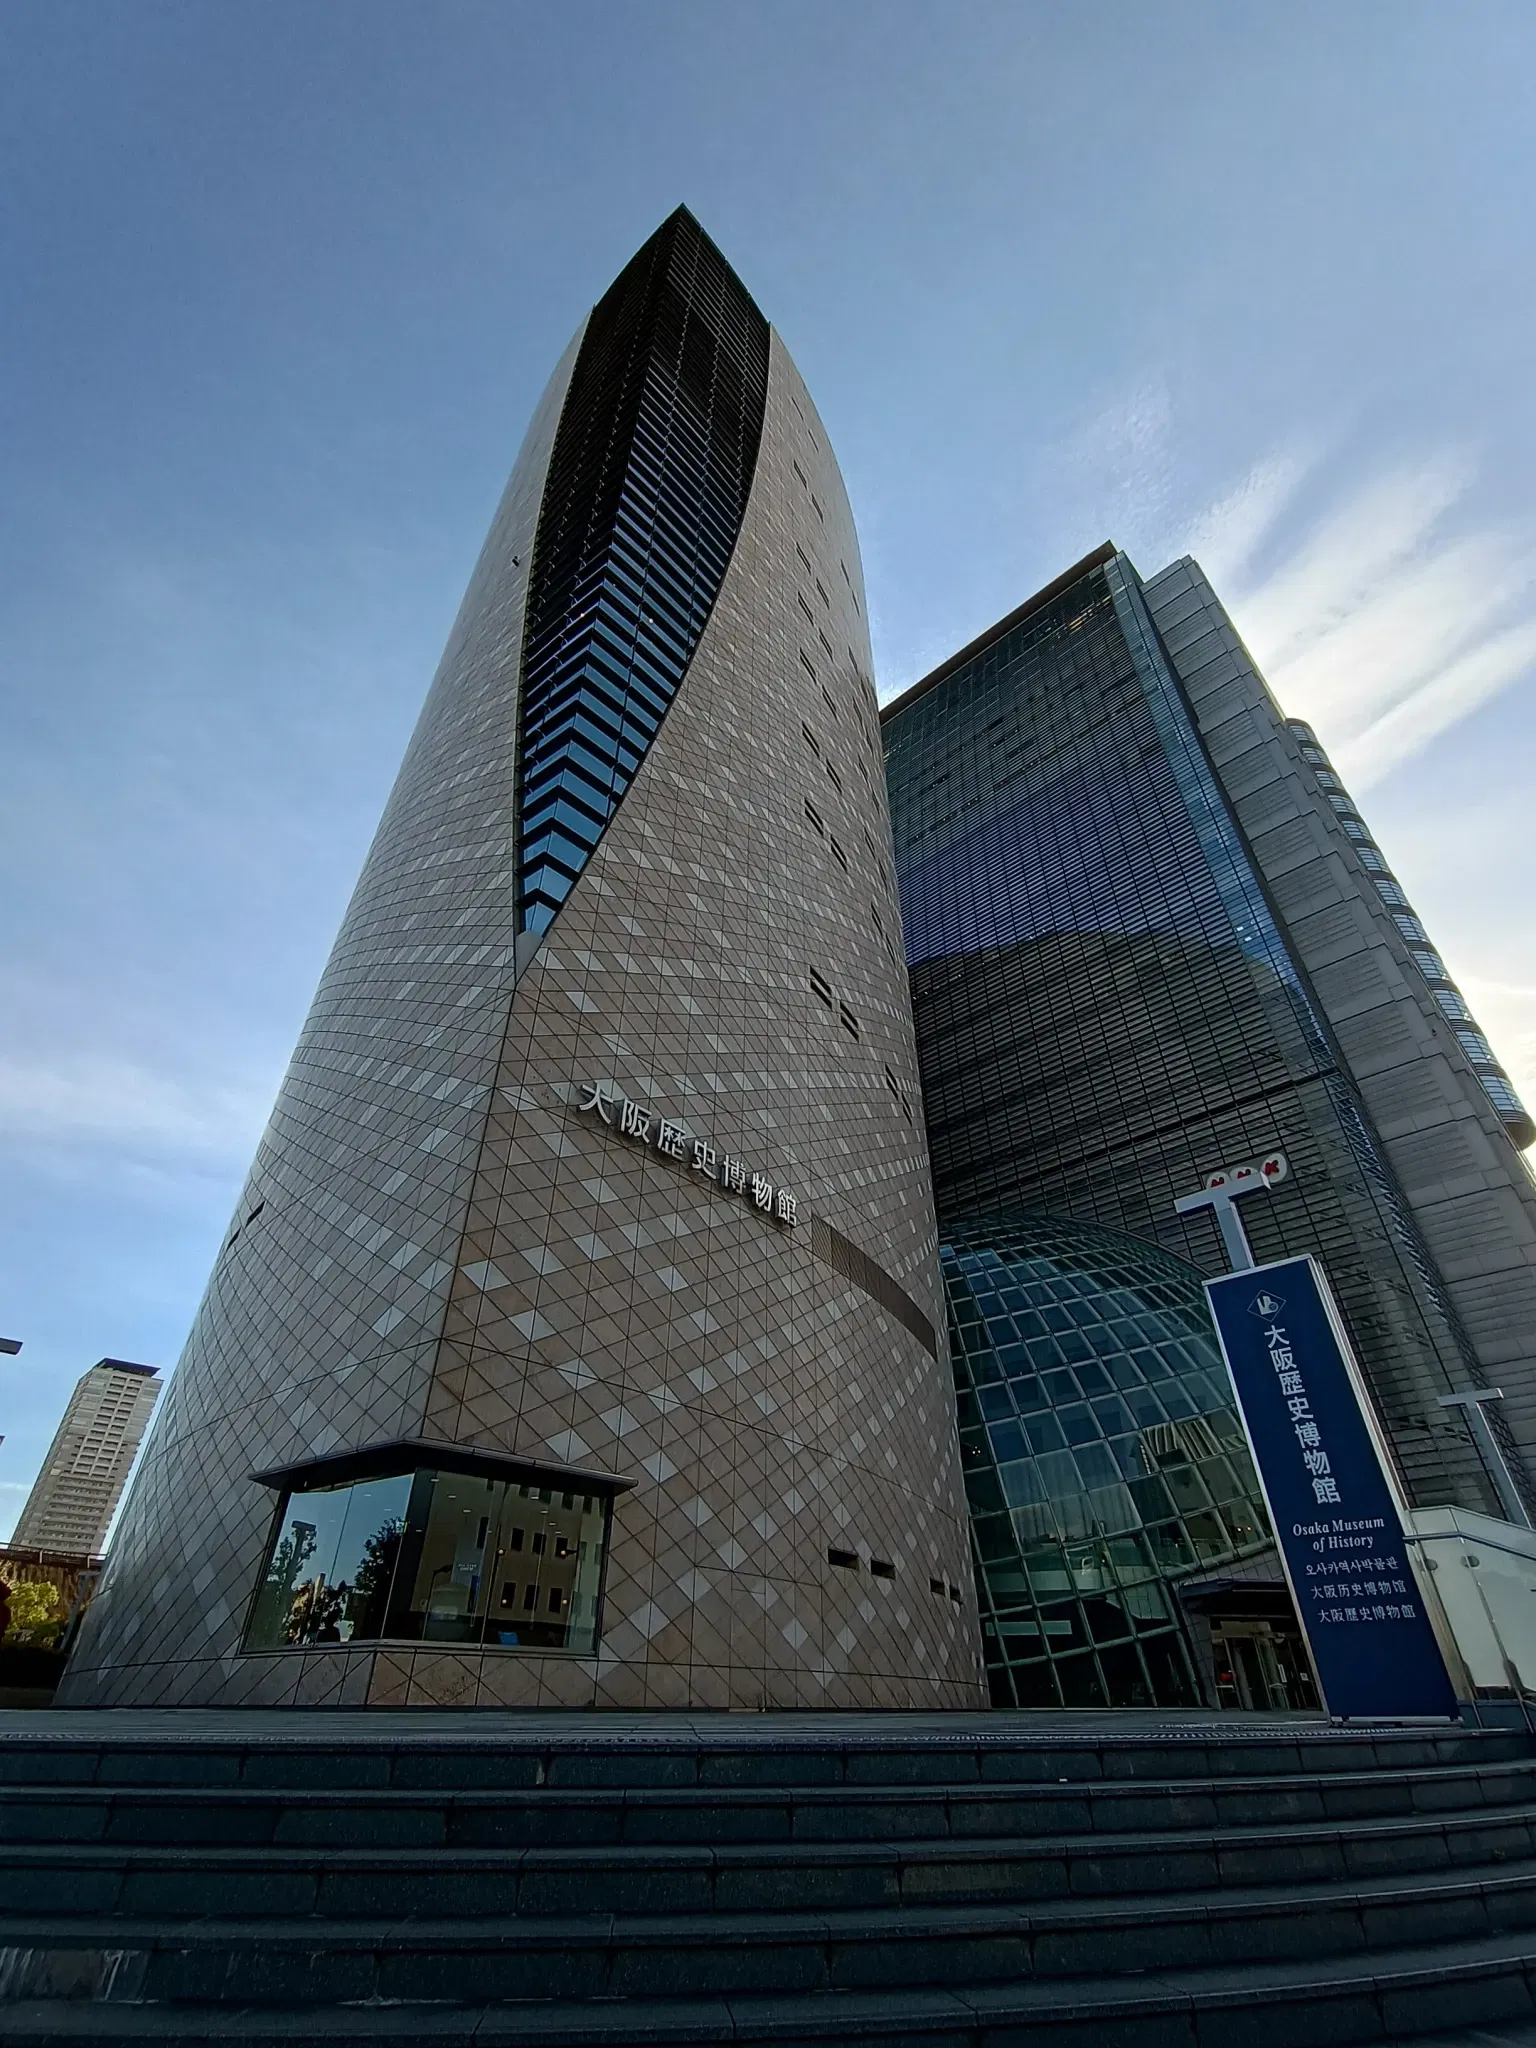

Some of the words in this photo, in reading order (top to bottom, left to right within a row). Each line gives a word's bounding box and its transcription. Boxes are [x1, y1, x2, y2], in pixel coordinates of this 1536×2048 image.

[578, 1083, 798, 1228] 大阪歴史博物館
[1263, 1324, 1341, 1504] 大阪歴史博物館
[1292, 1521, 1330, 1536] Osaka
[1331, 1518, 1385, 1533] Museum
[1312, 1536, 1326, 1553] of
[1328, 1535, 1374, 1549] History
[1305, 1556, 1399, 1576] 오사카역사박물관
[1310, 1579, 1407, 1600] 大阪历史博物馆
